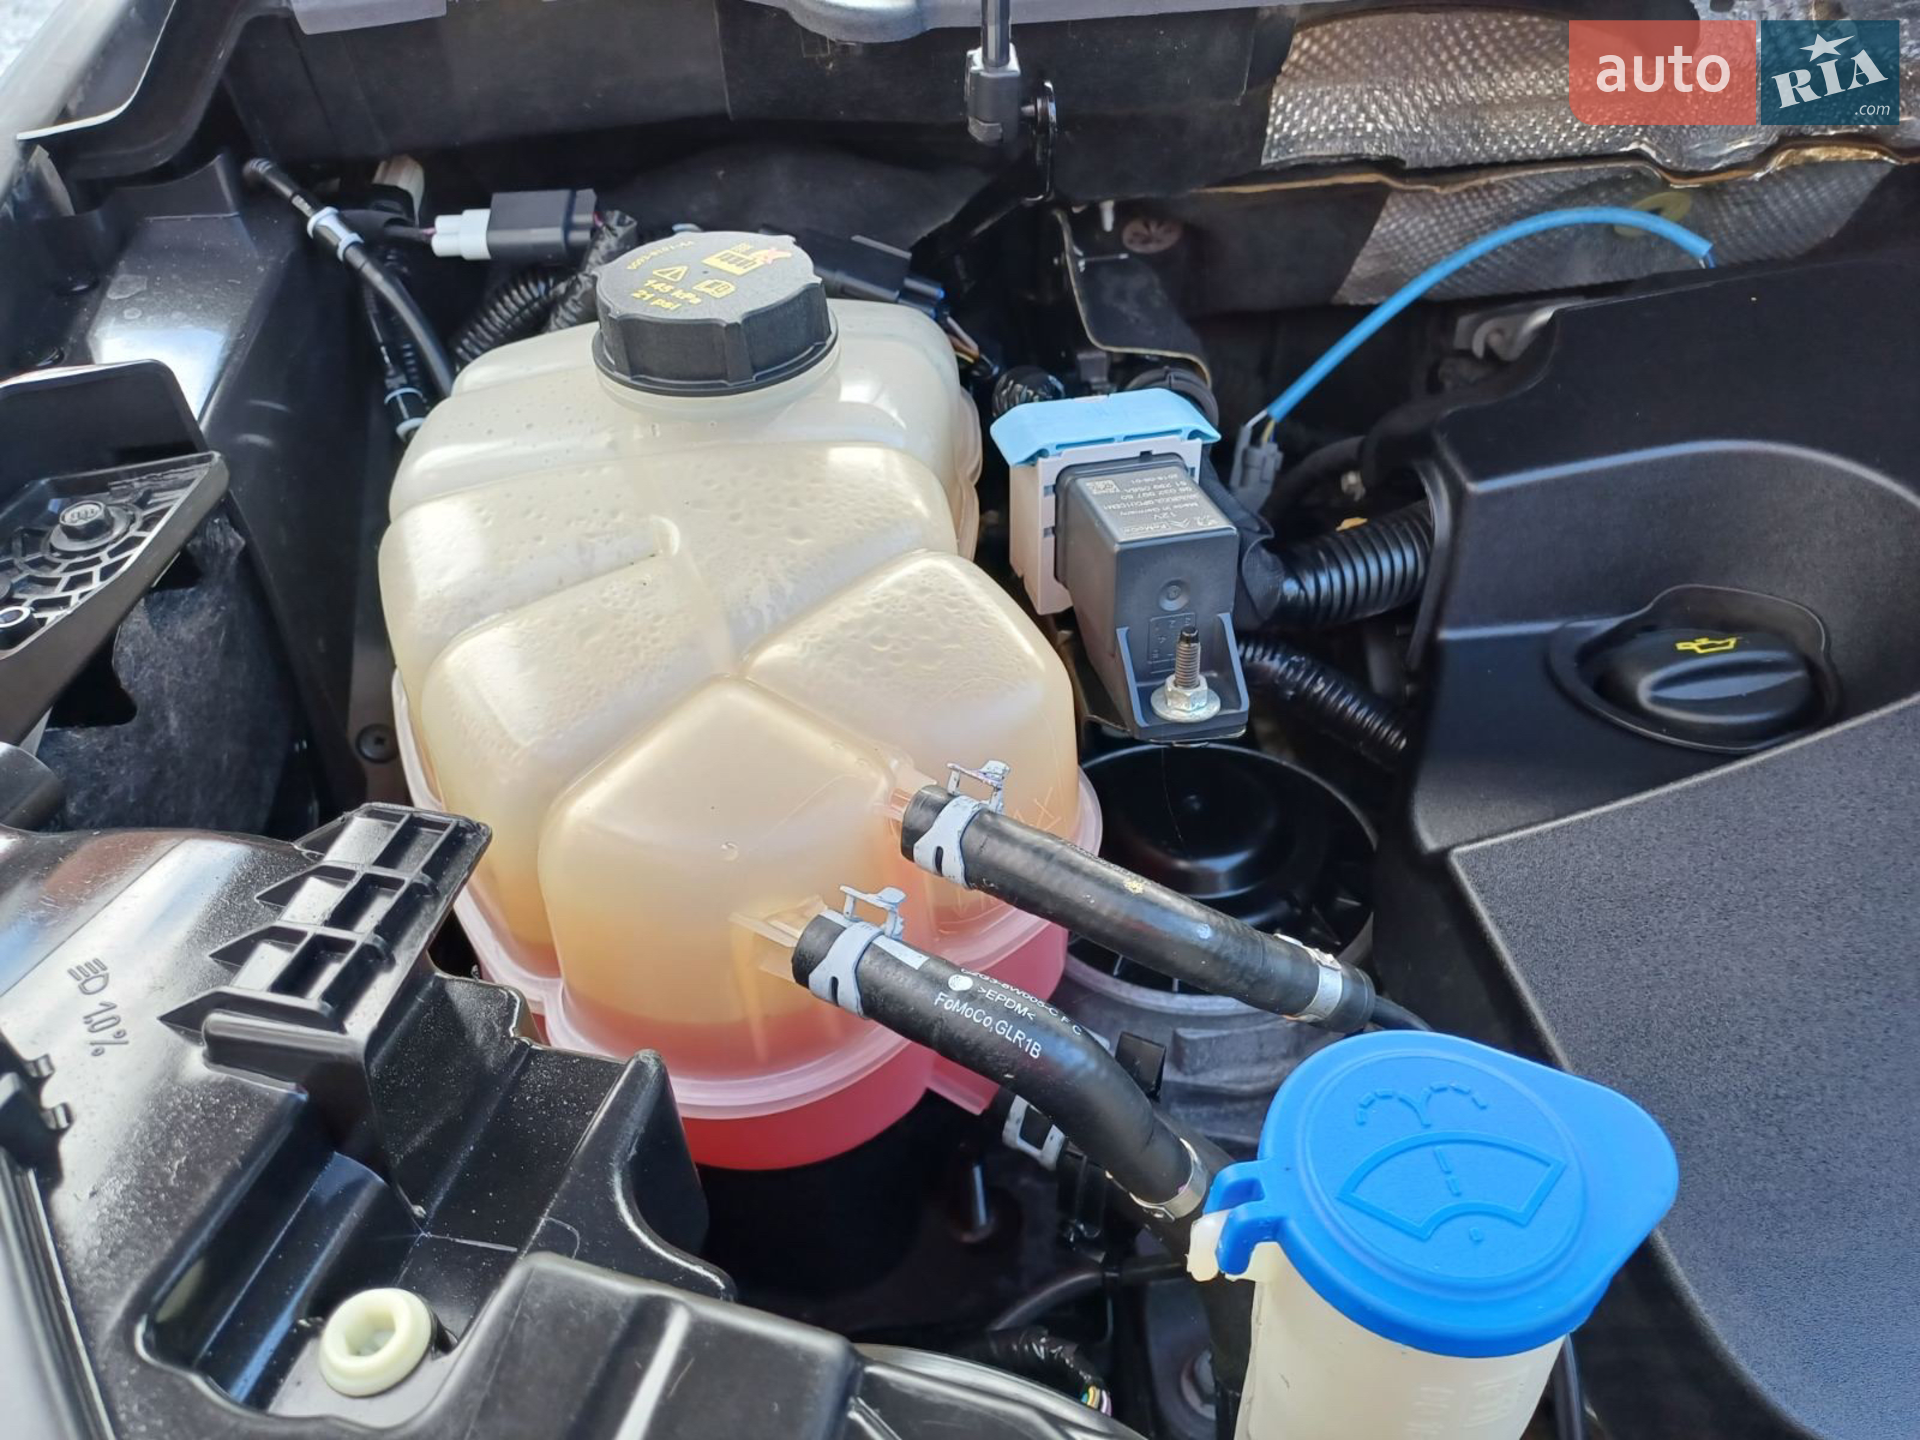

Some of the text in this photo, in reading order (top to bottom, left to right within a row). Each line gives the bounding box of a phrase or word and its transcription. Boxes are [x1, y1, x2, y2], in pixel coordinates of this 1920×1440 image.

[631, 288, 683, 311] 21 psi
[643, 278, 702, 305] 145 kPa
[1153, 511, 1177, 520] 12V
[977, 986, 1037, 1021] >EPDM<
